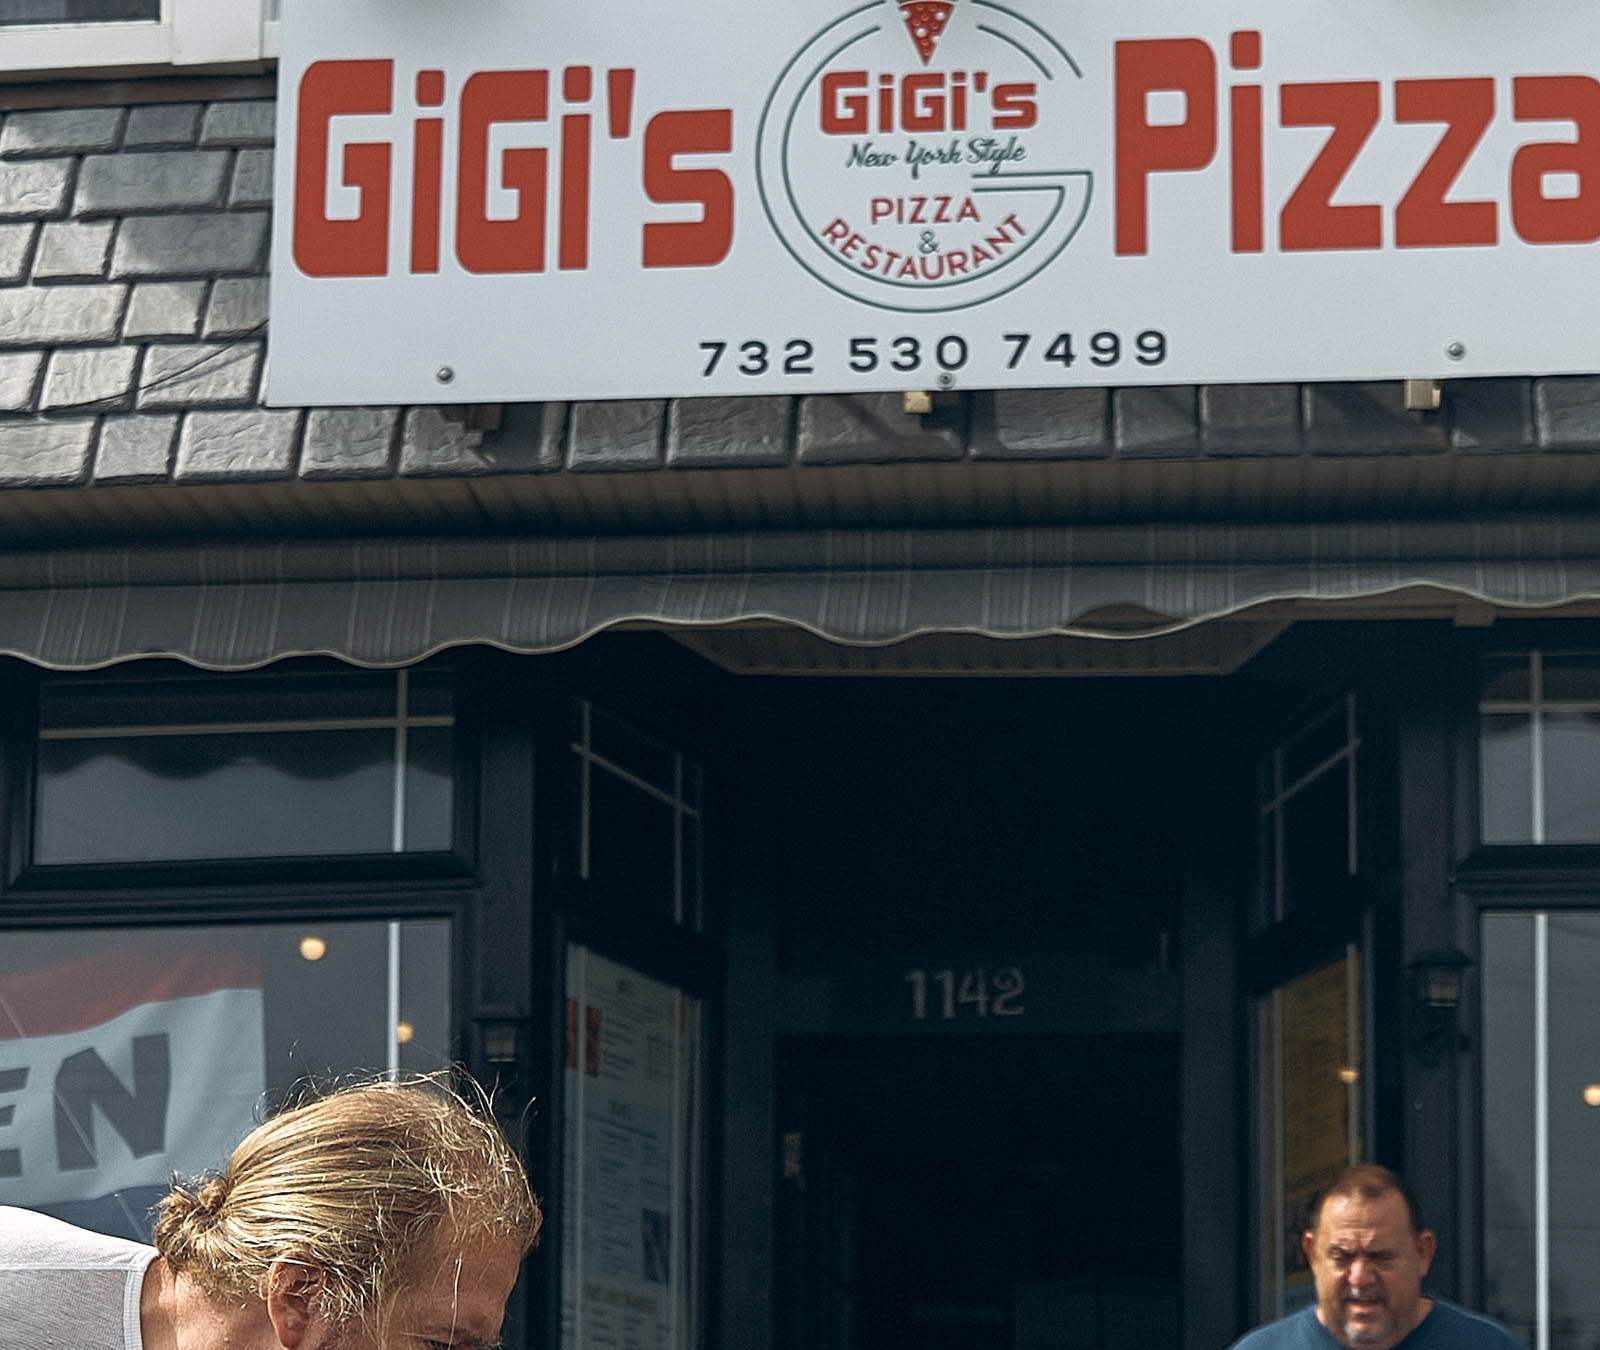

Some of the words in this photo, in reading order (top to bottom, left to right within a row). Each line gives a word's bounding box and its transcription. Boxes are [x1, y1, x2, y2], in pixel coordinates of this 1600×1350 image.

[820, 70, 1037, 135] GiGi's
[292, 58, 735, 279] GiGi's
[846, 143, 898, 168] New
[905, 140, 961, 180] York
[966, 137, 1027, 175] Style
[870, 197, 981, 224] PIZZA
[821, 214, 1027, 281] RESTAURANT
[918, 230, 940, 254] &
[699, 339, 815, 377] 732
[847, 335, 970, 374] 530
[1003, 330, 1168, 370] 7499
[905, 966, 1026, 1020] 1142
